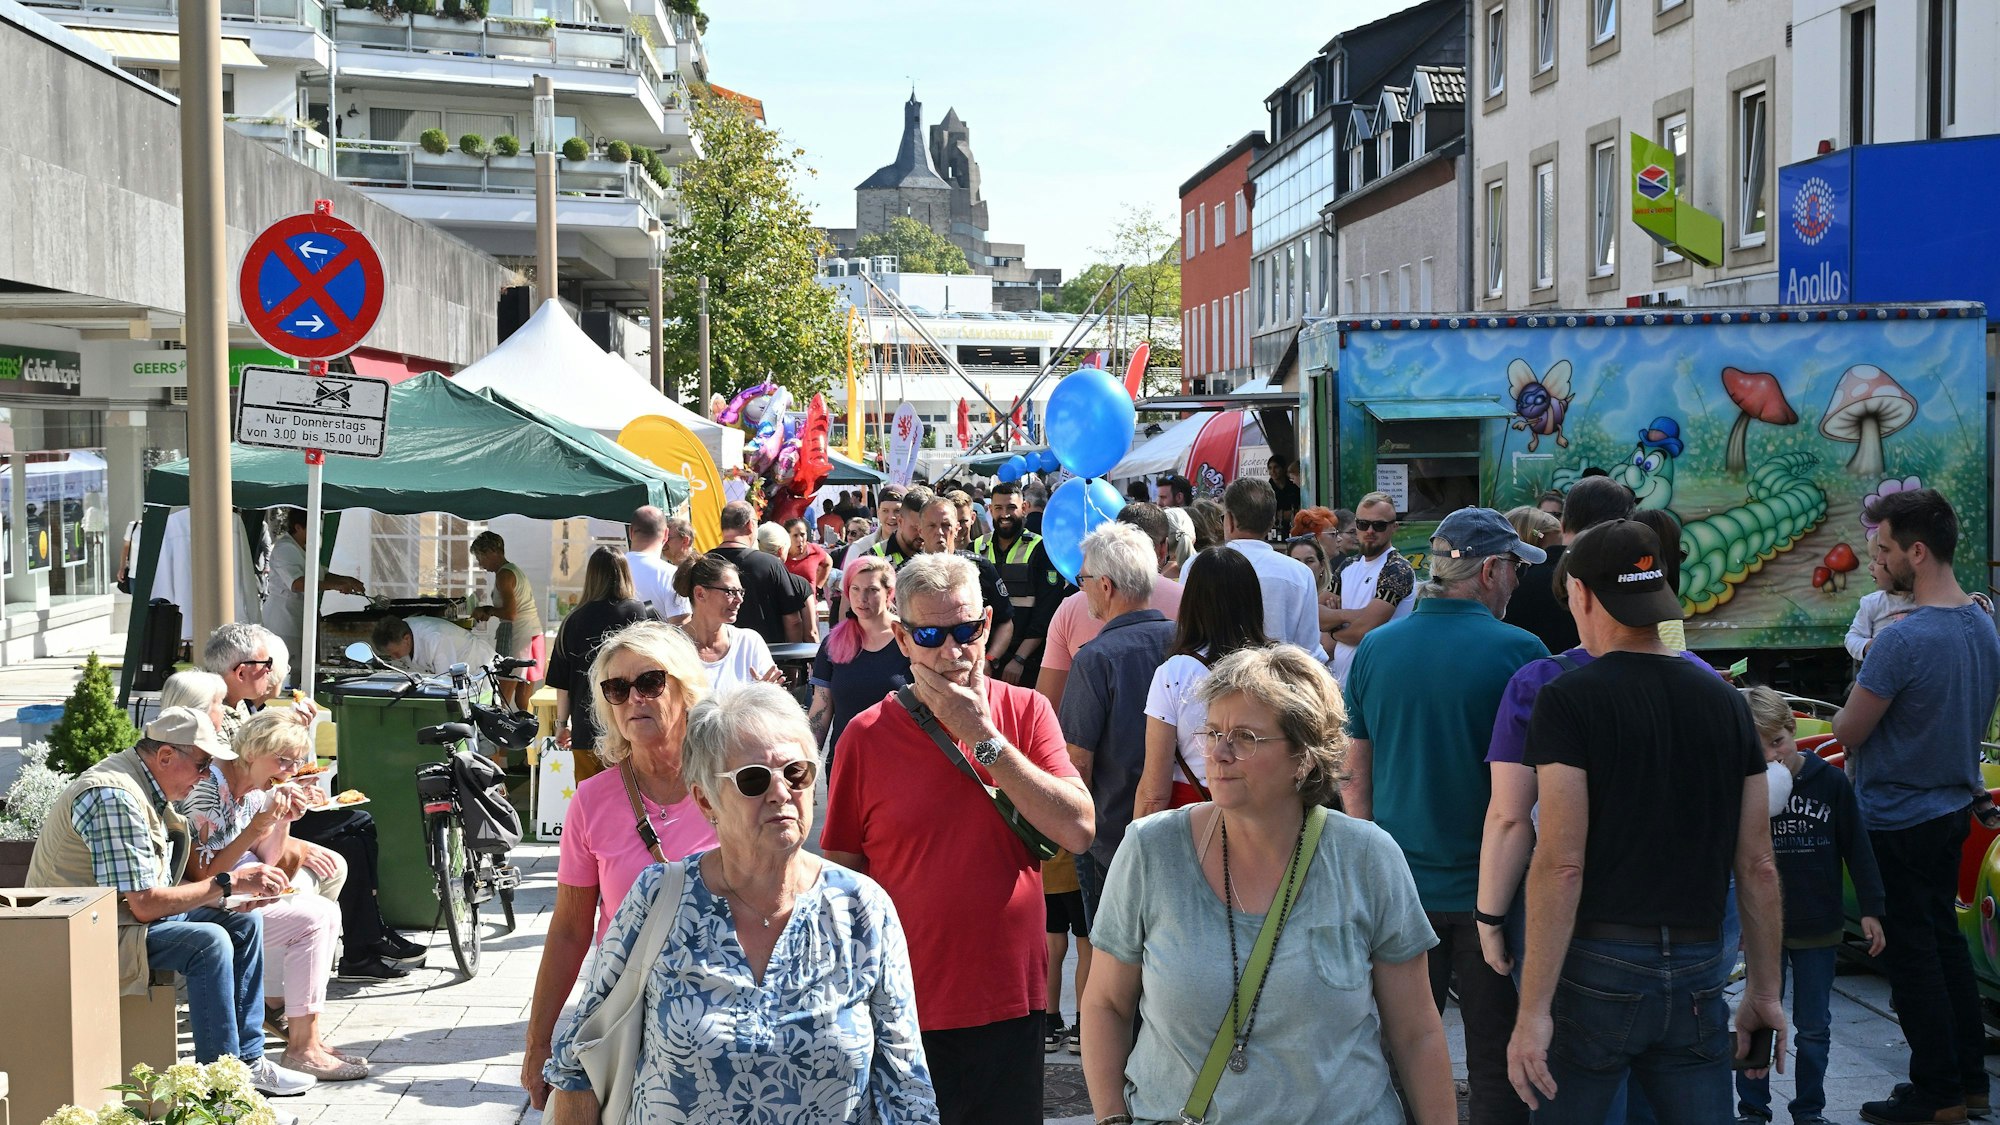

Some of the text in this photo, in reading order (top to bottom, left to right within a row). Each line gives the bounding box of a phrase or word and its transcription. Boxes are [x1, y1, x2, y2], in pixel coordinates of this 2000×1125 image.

[133, 362, 177, 375] GEERS
[266, 413, 366, 433] Nur Donnerstags
[246, 428, 379, 446] von 3.00 bis 15.00 Uhr
[541, 822, 563, 836] Lö
